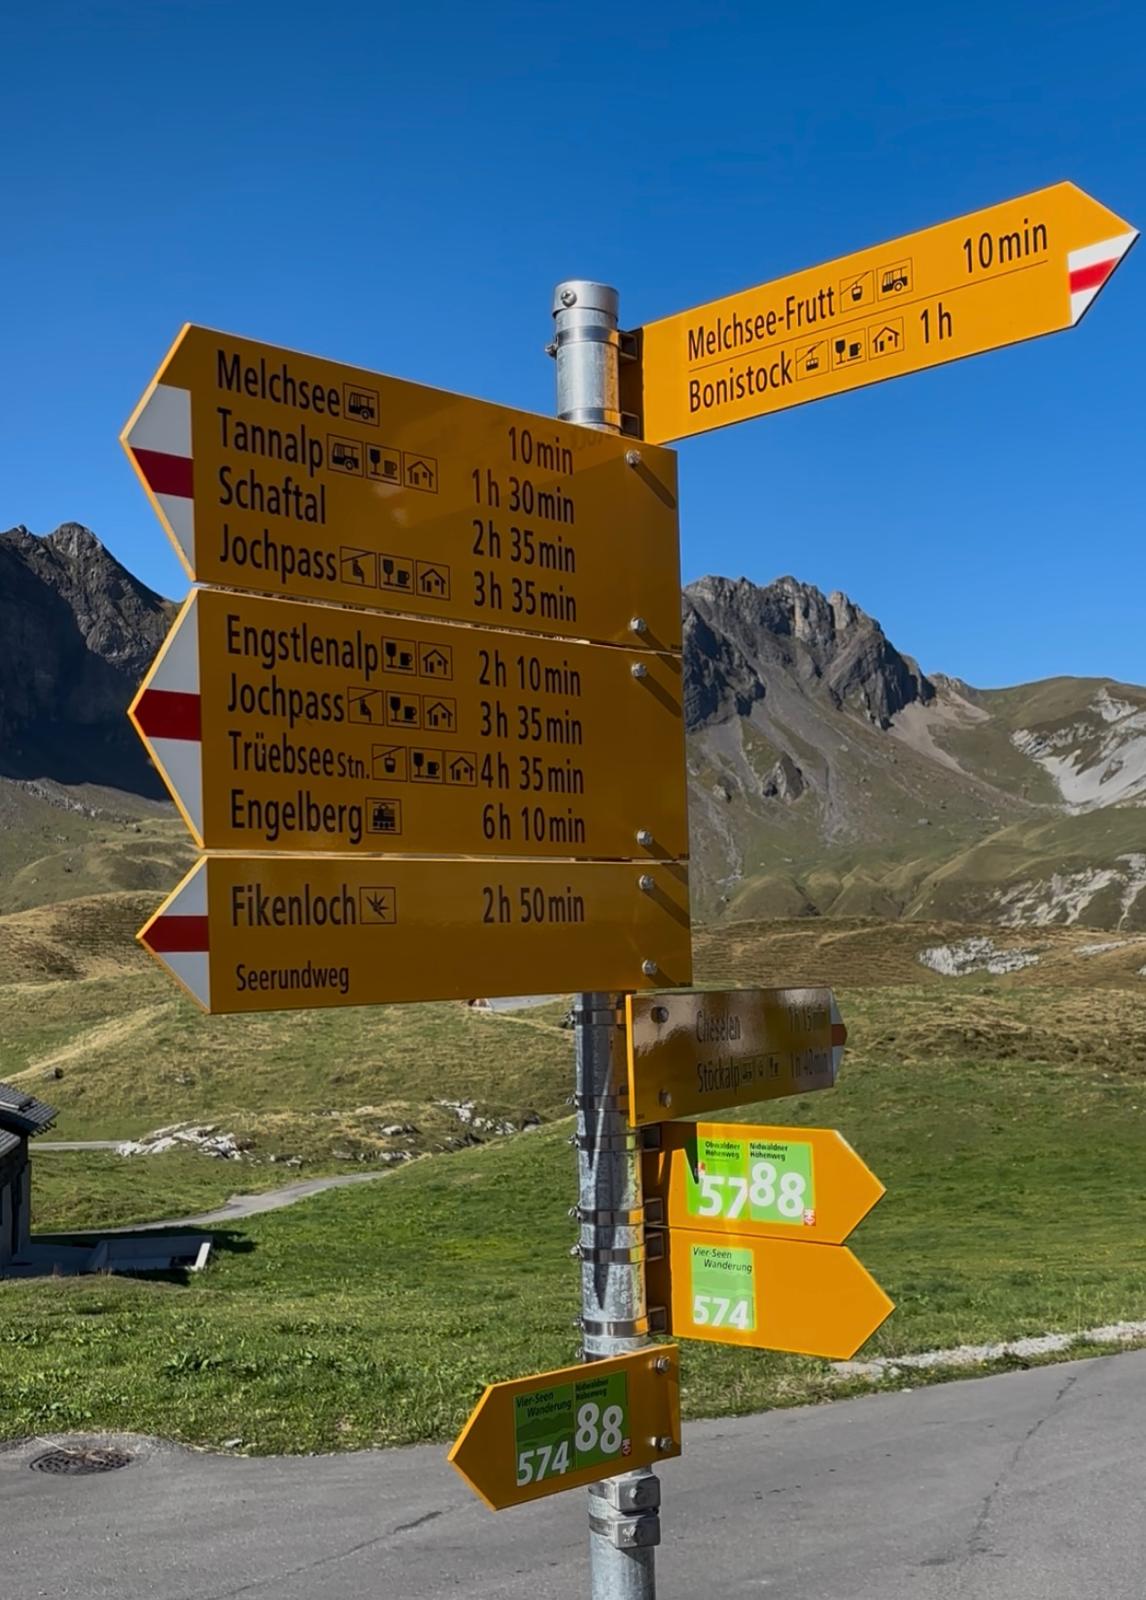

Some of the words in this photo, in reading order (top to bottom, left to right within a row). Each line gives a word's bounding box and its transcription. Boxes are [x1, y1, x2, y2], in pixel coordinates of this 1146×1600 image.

[688, 287, 836, 362] Melchsee-Frutt
[216, 350, 340, 417] Melchsee
[689, 351, 793, 413] Bonistock
[217, 407, 324, 478] Tannalp
[219, 465, 327, 524] Schaftal
[219, 523, 337, 585] Jochpass
[228, 615, 379, 682] Engstlenalp
[227, 673, 345, 730] Jochpass
[231, 789, 363, 844] Engelberg
[232, 884, 357, 927] Fikenloch
[237, 960, 350, 994] Seerundweg
[697, 1056, 740, 1096] Stöckalp
[698, 1174, 748, 1219] 57
[750, 1162, 806, 1217] 88
[704, 1259, 752, 1273] Wanderung
[693, 1295, 749, 1330] 574
[527, 1399, 572, 1418] Wanderung
[575, 1402, 623, 1454] 88
[516, 1441, 570, 1487] 574
